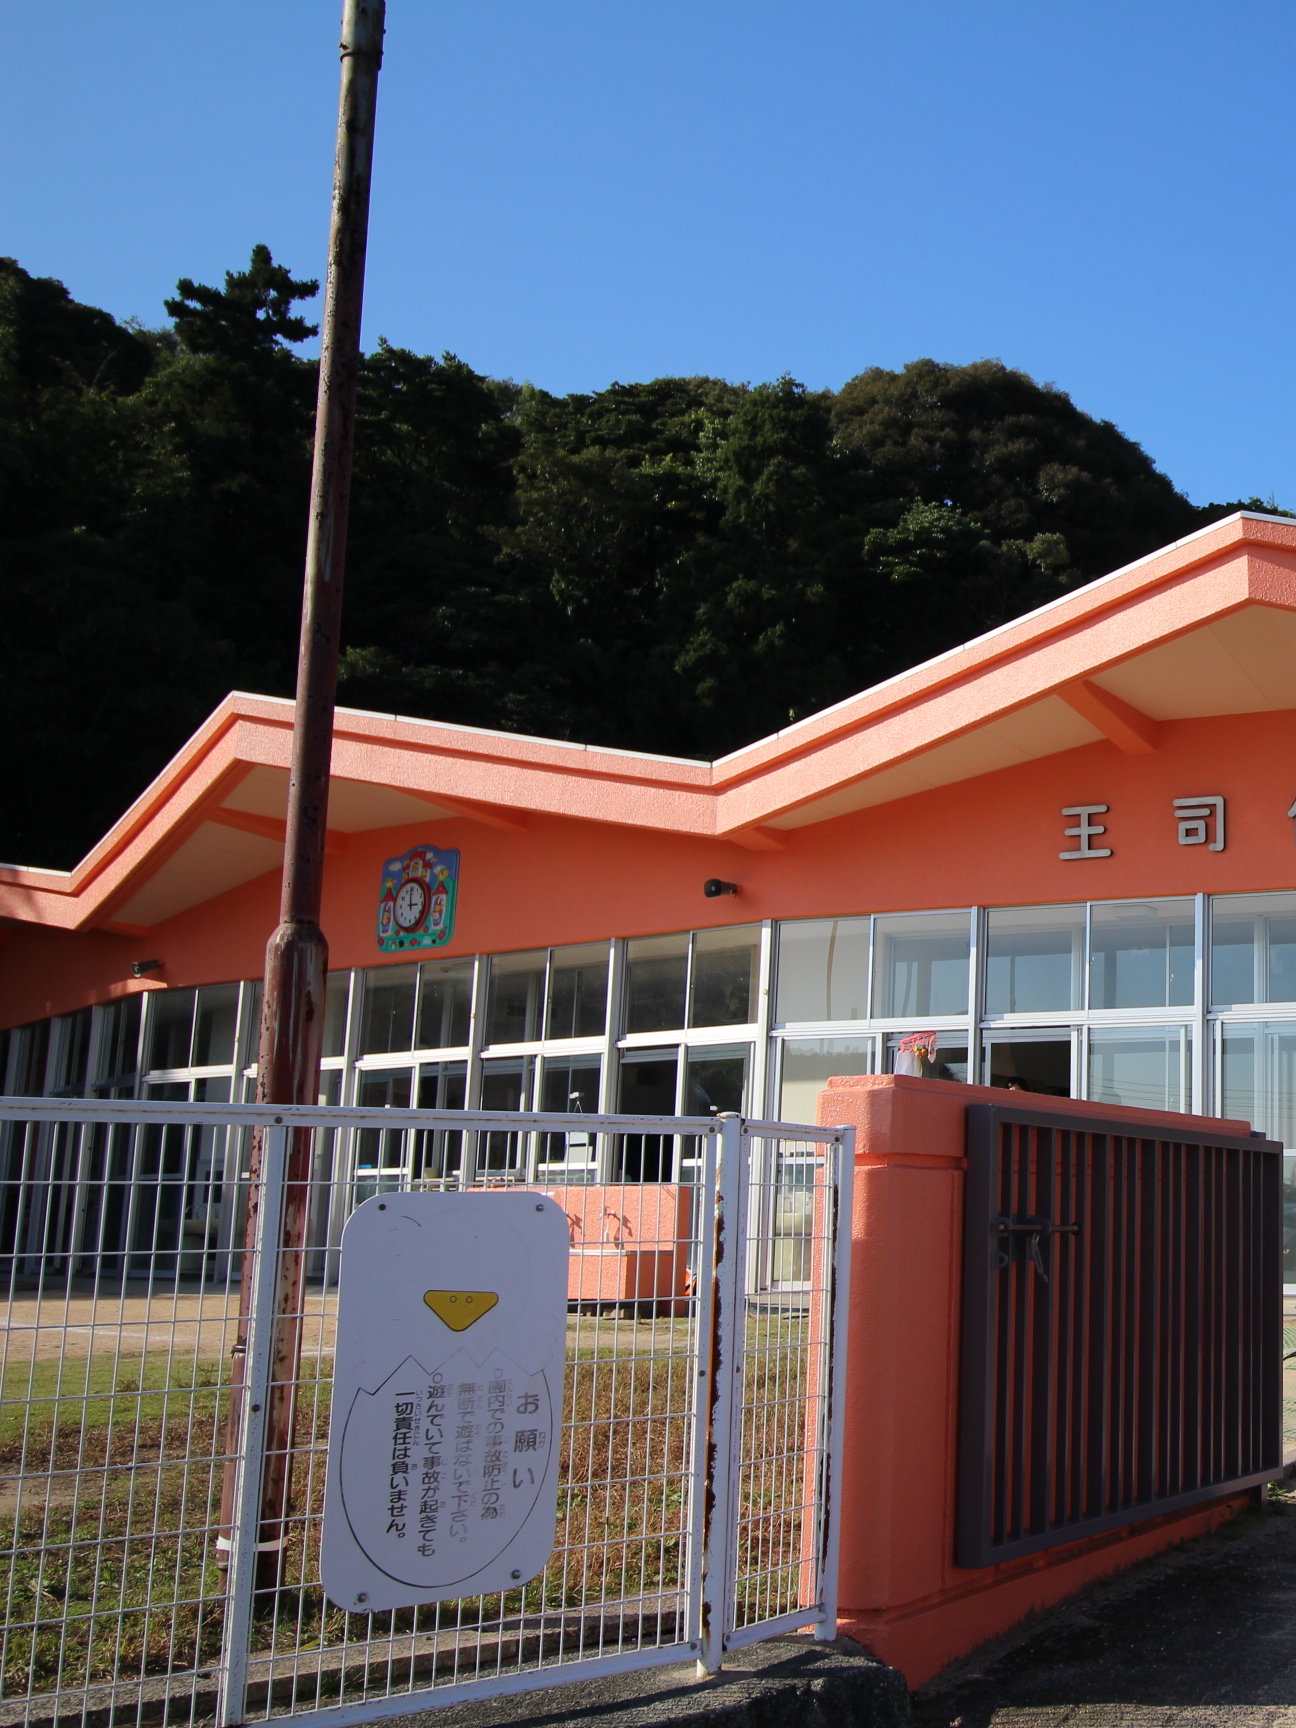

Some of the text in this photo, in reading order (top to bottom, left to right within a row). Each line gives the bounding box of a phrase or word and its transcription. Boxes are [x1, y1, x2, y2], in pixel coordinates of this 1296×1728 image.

[386, 1391, 416, 1539] 一切責任は負いません。
[512, 1392, 540, 1489] お願い
